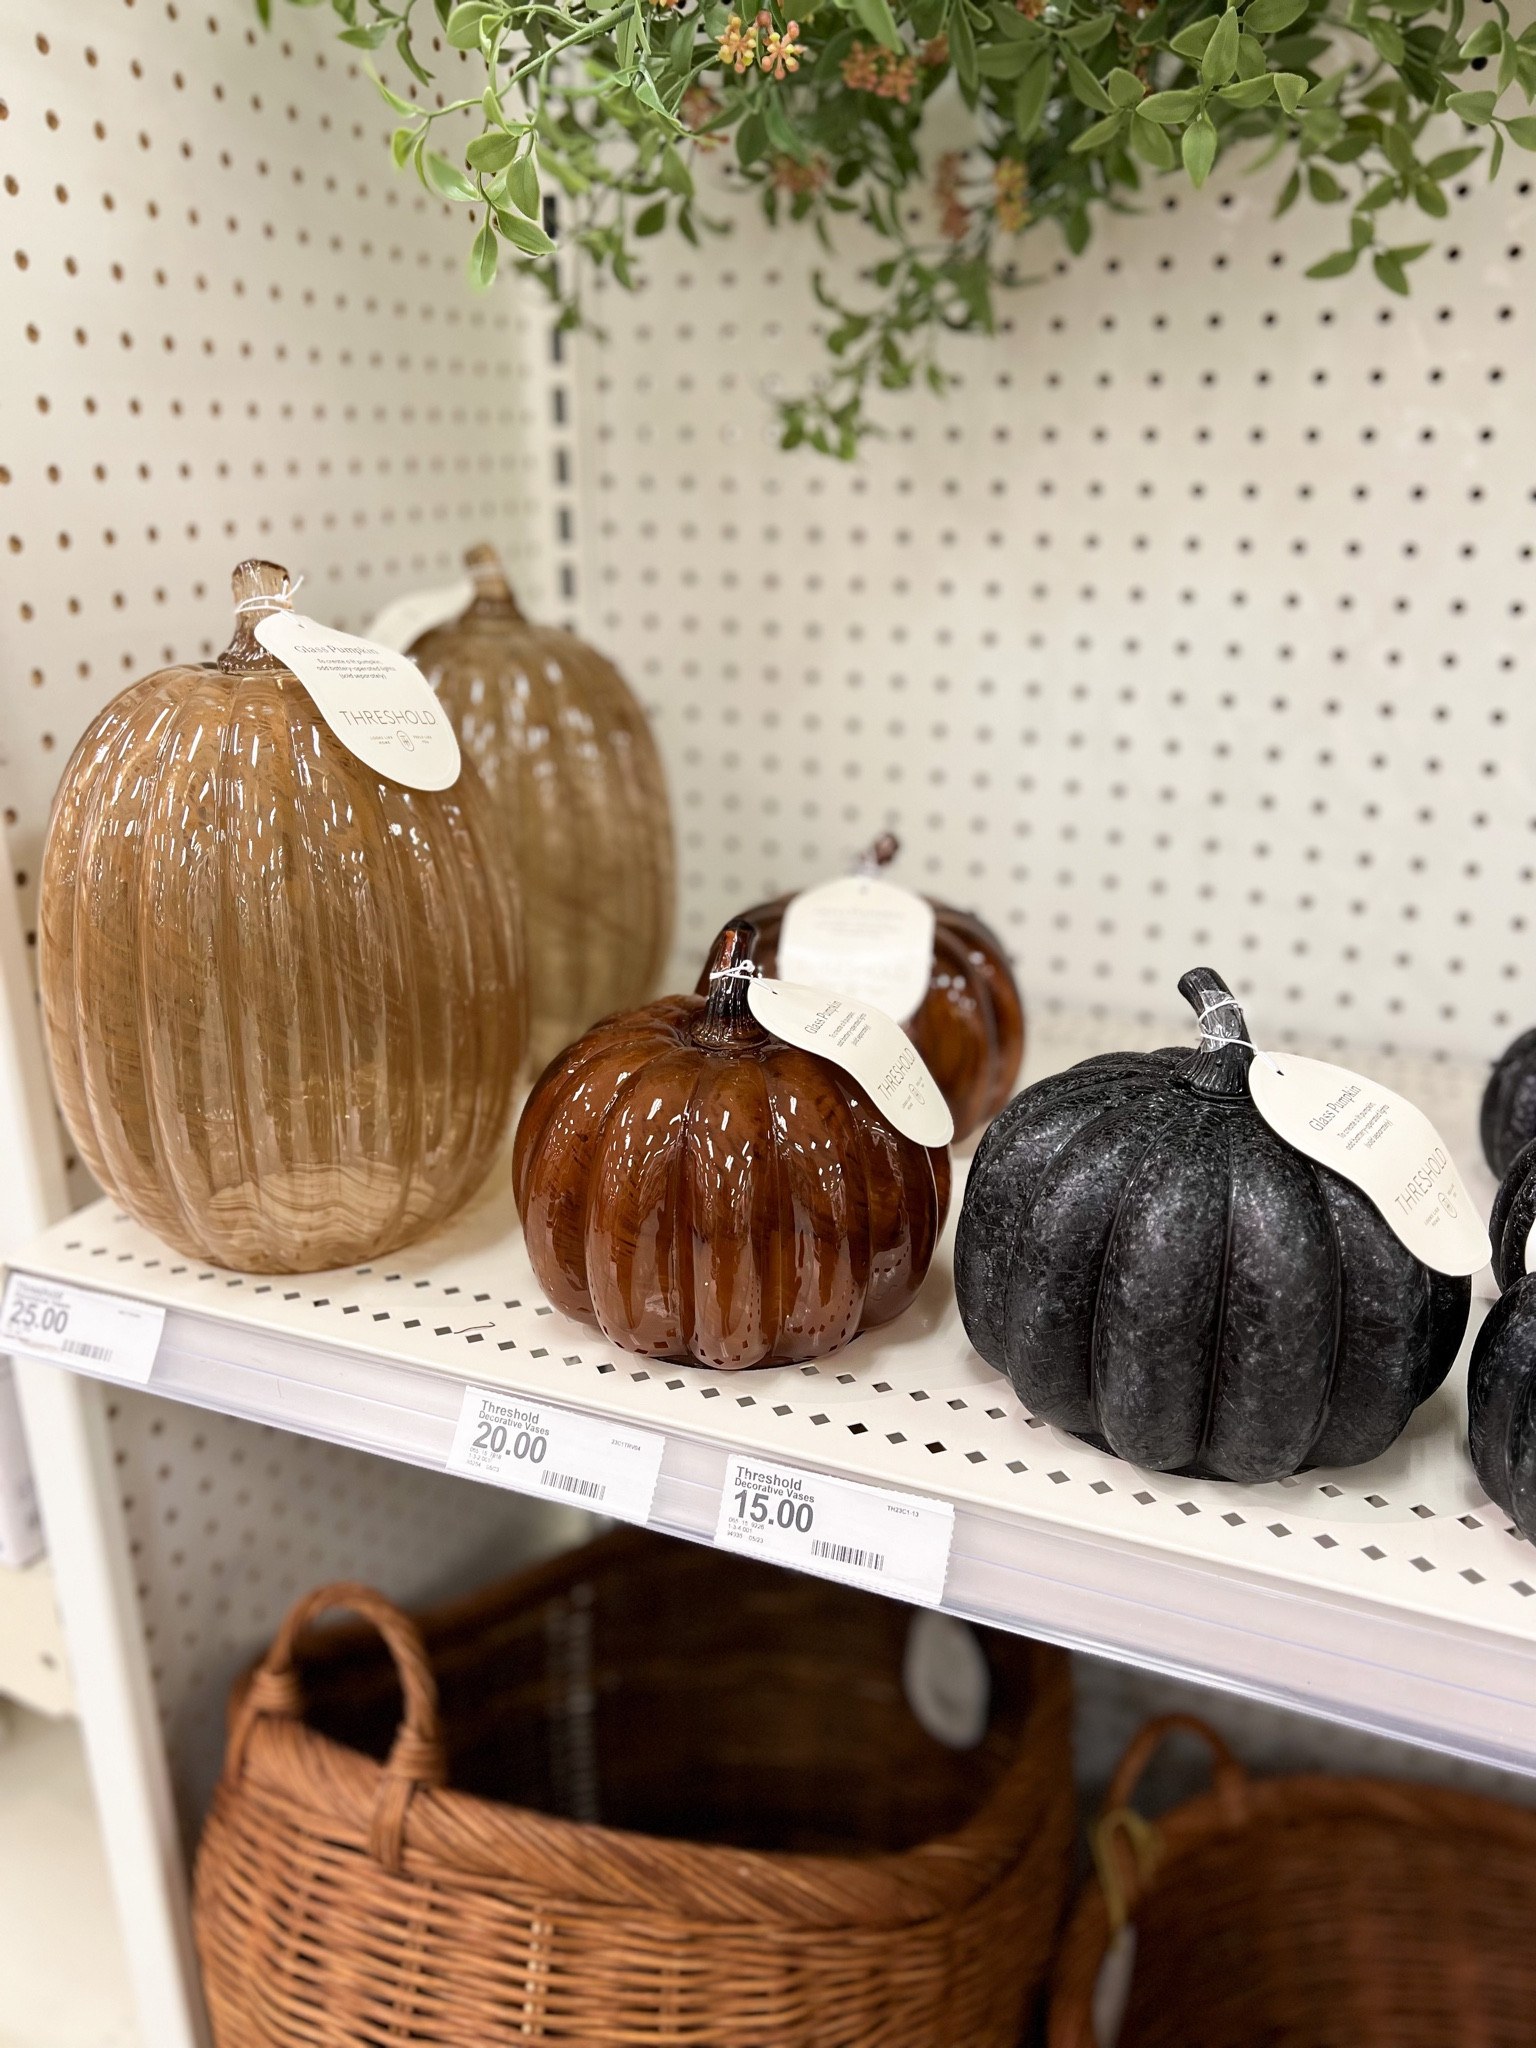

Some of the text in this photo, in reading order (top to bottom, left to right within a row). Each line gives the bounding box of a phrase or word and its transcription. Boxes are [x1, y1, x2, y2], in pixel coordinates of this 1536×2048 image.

[293, 644, 378, 656] Glass Pumpkin
[339, 710, 436, 725] THRESHOLD
[804, 1000, 842, 1034] Glass Pumpkin
[878, 1048, 916, 1100] THRESHOLD
[1308, 1085, 1362, 1131] Glass Pumpkin
[1394, 1148, 1446, 1216] THRESHOLD
[10, 1301, 68, 1334] 25.00
[479, 1410, 550, 1436] Decorative Vases
[482, 1400, 539, 1425] Threshold
[472, 1421, 547, 1464] 20.00
[735, 1477, 815, 1503] Decorative Vases
[736, 1466, 802, 1491] Threshold
[734, 1490, 814, 1532] 15.00
